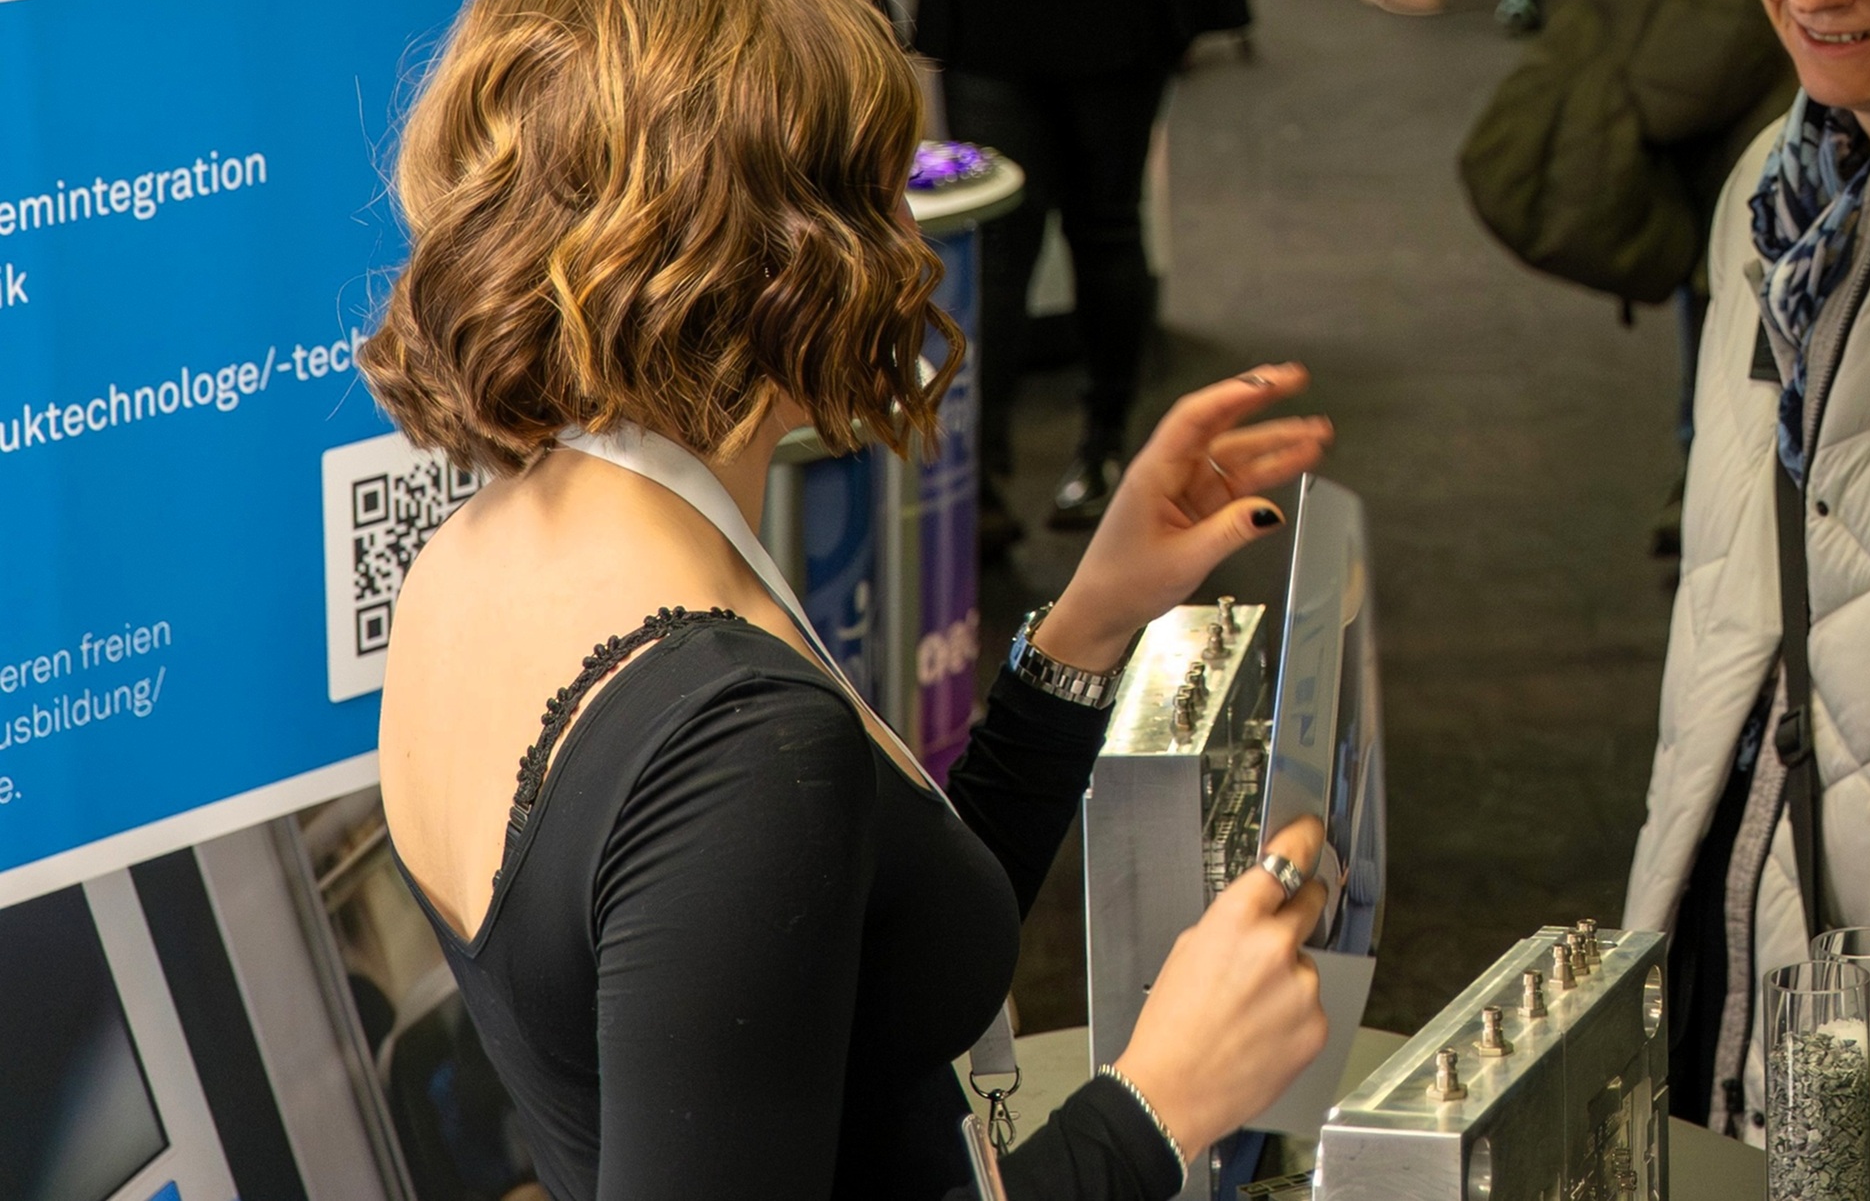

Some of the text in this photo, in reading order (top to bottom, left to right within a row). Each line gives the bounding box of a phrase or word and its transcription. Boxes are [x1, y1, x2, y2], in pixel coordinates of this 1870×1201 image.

[0, 151, 267, 235] emintegration
[0, 620, 172, 693] eren freien
